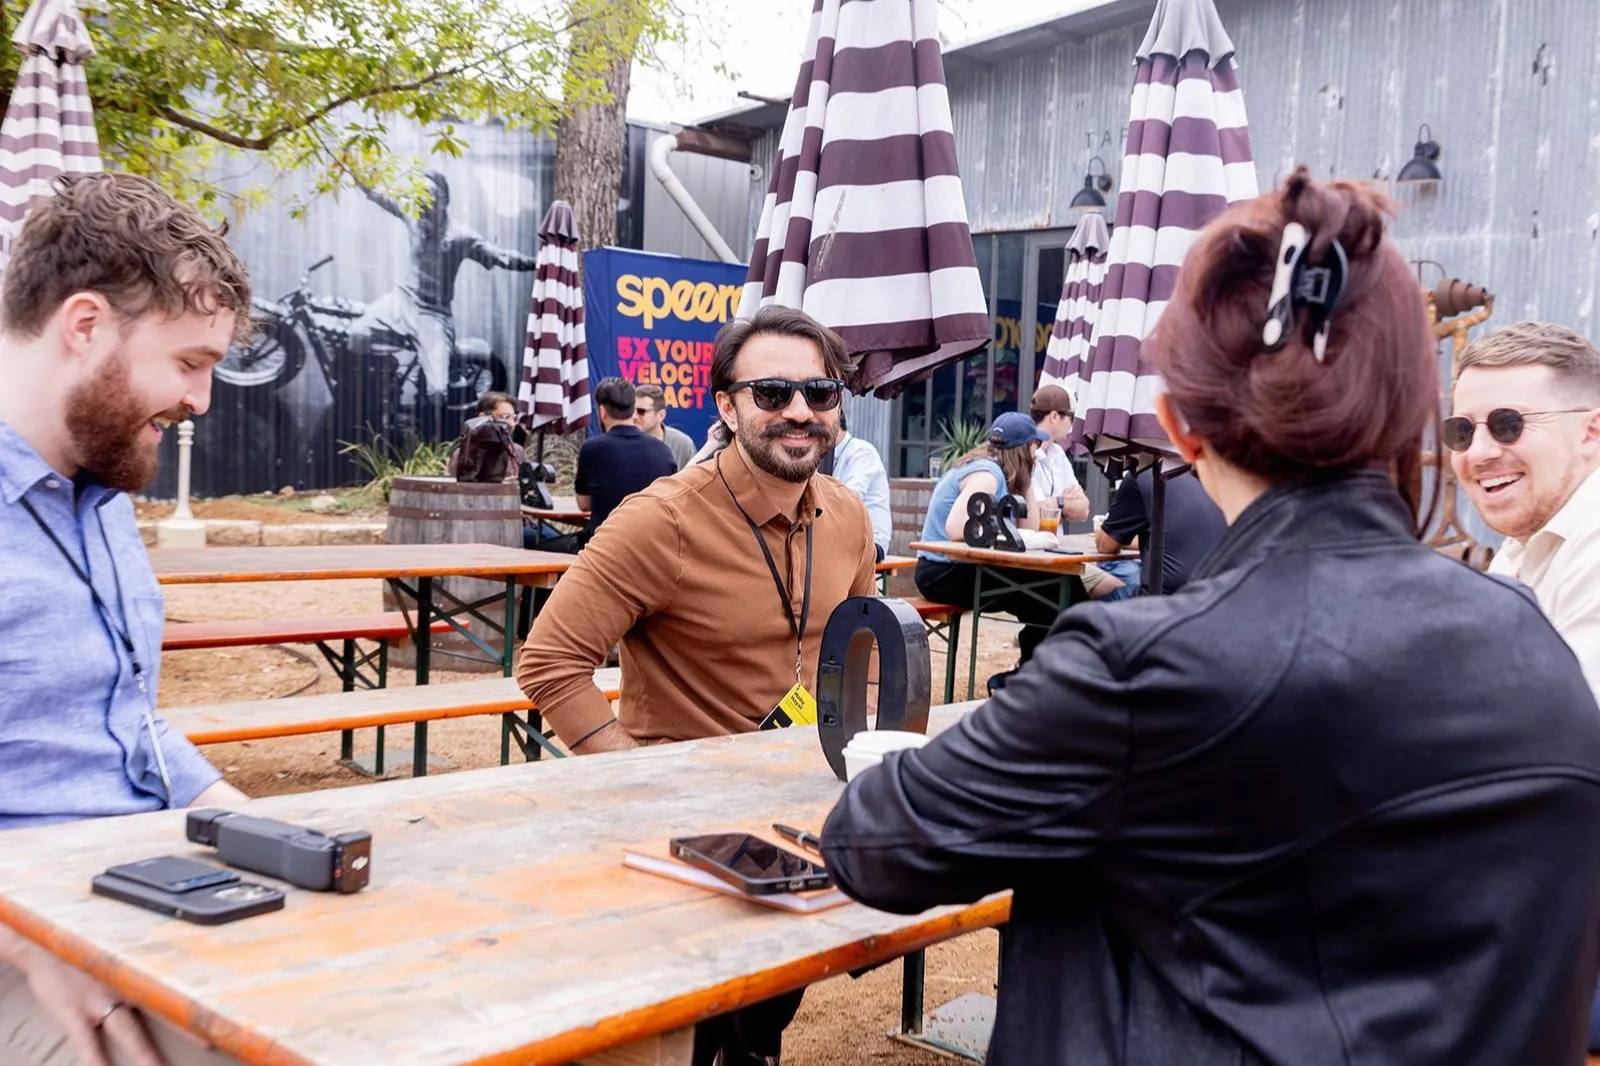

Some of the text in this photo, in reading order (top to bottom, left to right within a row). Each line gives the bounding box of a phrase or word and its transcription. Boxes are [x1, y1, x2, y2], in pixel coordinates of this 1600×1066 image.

[617, 336, 714, 364] 5X YOUR
[618, 361, 712, 388] VELOCIT
